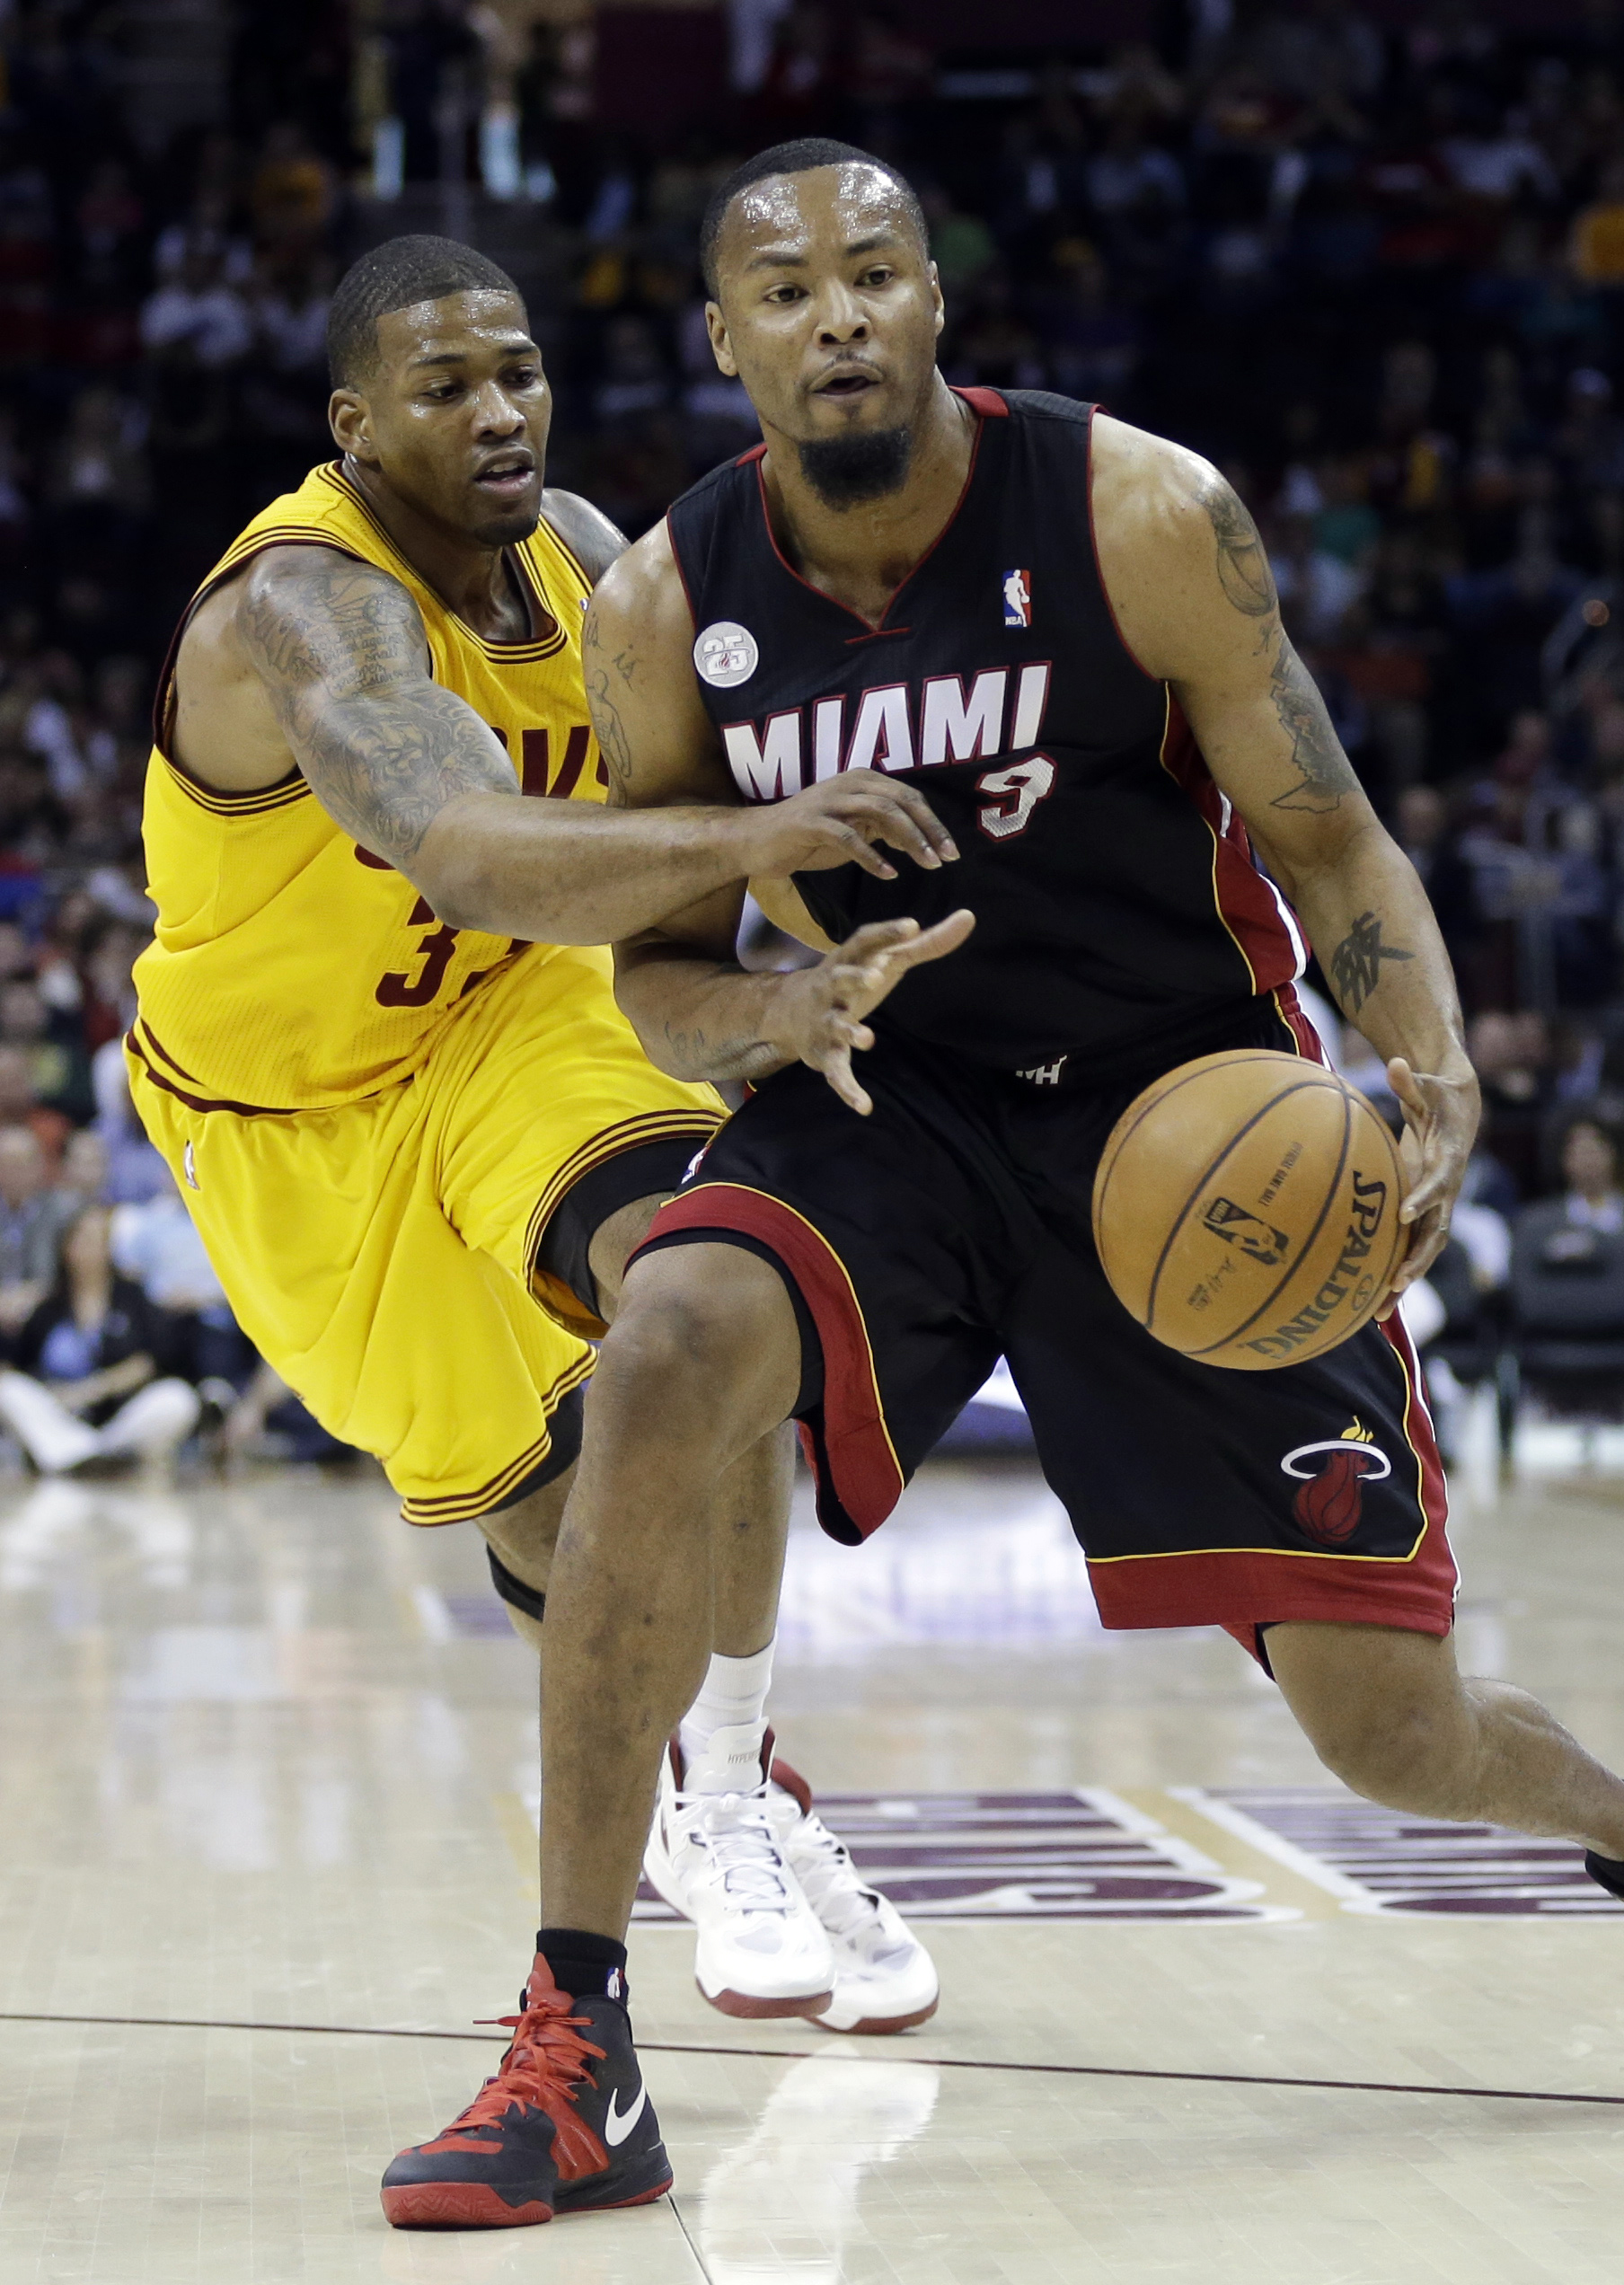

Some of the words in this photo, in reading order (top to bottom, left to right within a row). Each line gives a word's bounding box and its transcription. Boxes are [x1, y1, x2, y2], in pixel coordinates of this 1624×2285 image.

[702, 634, 749, 676] 25
[720, 660, 1053, 806] MIAMI
[975, 751, 1058, 843] 9
[1246, 1169, 1387, 1360] SPALDING
